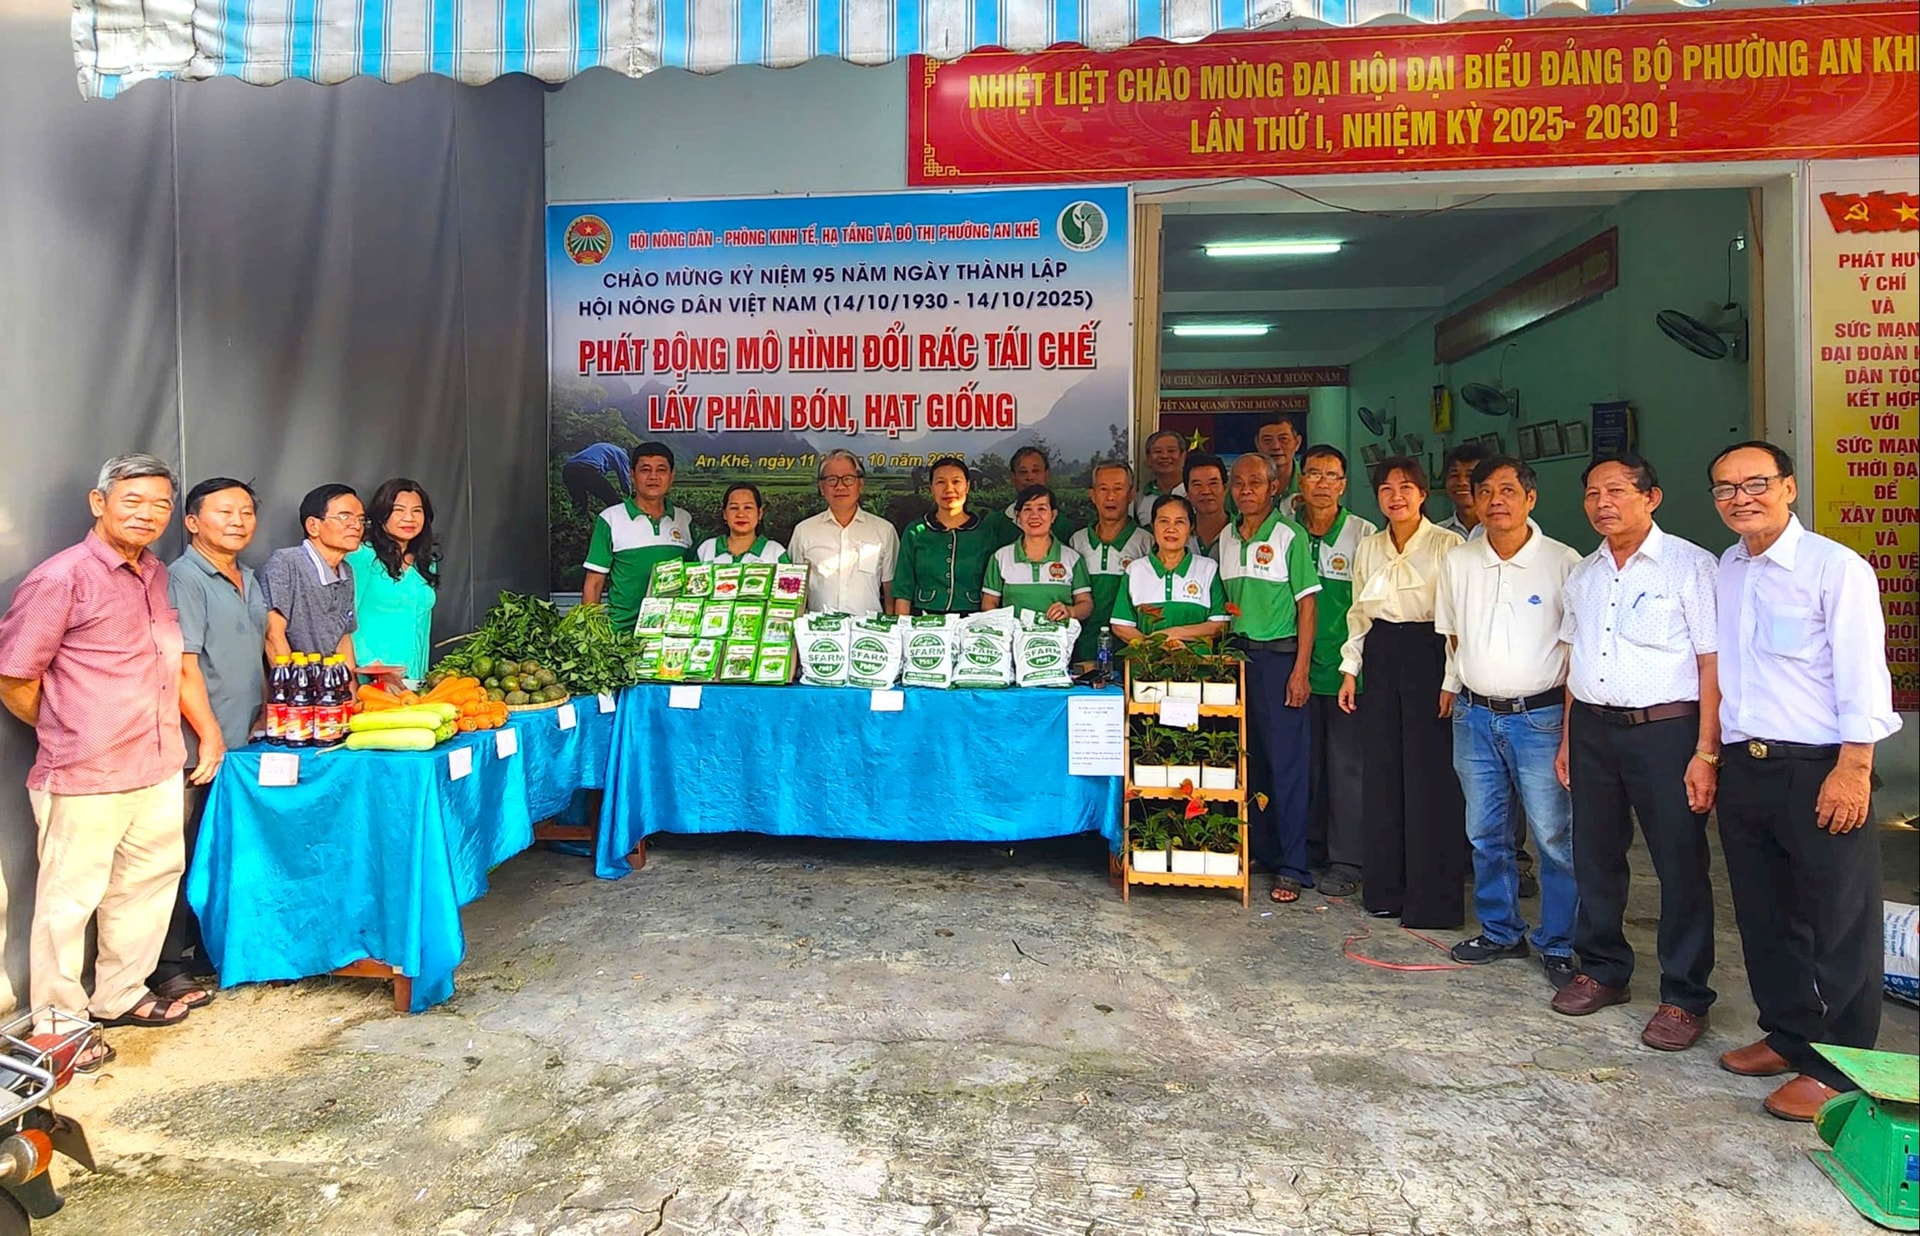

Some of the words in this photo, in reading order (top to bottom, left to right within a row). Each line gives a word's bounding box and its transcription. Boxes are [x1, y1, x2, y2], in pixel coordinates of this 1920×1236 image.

[968, 66, 1046, 115] NHIỆT
[1054, 63, 1109, 112] LIỆT
[1117, 60, 1191, 103] CHÀO
[1201, 57, 1284, 100] MỪNG
[1293, 60, 1340, 103] ĐẠI
[1350, 51, 1397, 101] HỘI
[1406, 55, 1455, 99] ĐẠI
[1465, 37, 1531, 89] BIỂU
[1540, 37, 1622, 87] ĐẢNG
[1633, 39, 1673, 91] BỘ
[1683, 33, 1808, 81] PHƯỜNG
[1819, 38, 1862, 76] AN
[1190, 106, 1244, 154] LẦN
[1253, 108, 1310, 152] THỨ
[1315, 114, 1333, 154] I,
[1342, 103, 1437, 155] NHIỆM
[1447, 101, 1483, 145] KỲ
[1586, 102, 1658, 140] 2030
[629, 231, 649, 252] HỘI
[653, 230, 685, 248] NÔNG
[689, 229, 713, 248] DÂN
[725, 227, 765, 247] PHÒNG
[769, 228, 798, 246] KINH
[801, 222, 819, 246] TẾ,
[822, 227, 838, 247] HẠ
[877, 223, 893, 242] VÀ
[895, 220, 912, 241] ĐÔ
[916, 224, 935, 244] THỊ
[939, 219, 990, 240] PHƯỜNG
[993, 222, 1012, 239] AN
[1014, 218, 1039, 238] KHÊ
[1838, 250, 1885, 268] PHÁT
[1891, 252, 1919, 267] HU
[603, 269, 659, 288] CHÀO
[666, 266, 723, 287] MỪNG
[730, 263, 753, 285] KỶ
[761, 264, 805, 288] NIỆM
[812, 267, 835, 283] 95
[842, 262, 886, 282] NĂM
[893, 260, 950, 281] NGÀY
[956, 259, 1024, 280] THÀNH
[1031, 258, 1067, 283] LẬP
[1859, 273, 1870, 291] Ý
[1876, 272, 1906, 291] CHÍ
[578, 296, 612, 320] HỘI
[619, 295, 675, 315] NÔNG
[682, 294, 722, 314] DÂN
[728, 292, 766, 317] VIỆT
[772, 295, 816, 313] NAM
[823, 292, 948, 316] (14/10/1930
[967, 289, 1093, 311] 14/10/2025)
[1871, 296, 1895, 314] VÀ
[1835, 321, 1871, 338] SỨC
[579, 332, 646, 374] PHÁT
[653, 330, 728, 380] ĐỘNG
[736, 329, 781, 373] MÔ
[788, 328, 856, 372] HÌNH
[863, 320, 909, 370] ĐỔI
[918, 325, 977, 369] RÁC
[984, 325, 1029, 368] TÁI
[1037, 320, 1099, 368] CHẾ
[1821, 346, 1851, 364] ĐẠI
[1857, 343, 1907, 361] ĐOÀN
[1231, 372, 1255, 387] VIỆT
[1258, 373, 1281, 384] NAM
[1845, 365, 1883, 384] DÂN
[1177, 400, 1198, 410] NAM
[1231, 399, 1253, 409] VINH
[1847, 387, 1880, 407] KẾT
[648, 384, 699, 431] LẤY
[706, 388, 781, 431] PHÂN
[790, 386, 857, 434] BÓN,
[864, 393, 918, 438] HẠT
[925, 381, 1015, 430] GIỐNG
[1870, 412, 1900, 430] VỚI
[1836, 435, 1873, 453] SỨC
[695, 454, 720, 468] An
[723, 453, 754, 470] Khê,
[758, 454, 796, 471] ngày
[800, 455, 815, 468] 11
[868, 453, 886, 467] 10
[889, 453, 922, 467] năm
[1847, 458, 1887, 477] THỜI
[1874, 479, 1898, 499] ĐỂ
[1840, 505, 1876, 523] XÂY
[1875, 527, 1898, 546] VÀ
[1860, 549, 1892, 569] ẢO
[808, 654, 845, 662] SFARM
[851, 649, 889, 662] SFARM
[910, 647, 946, 657] SFARM
[1025, 647, 1061, 659] SFARM
